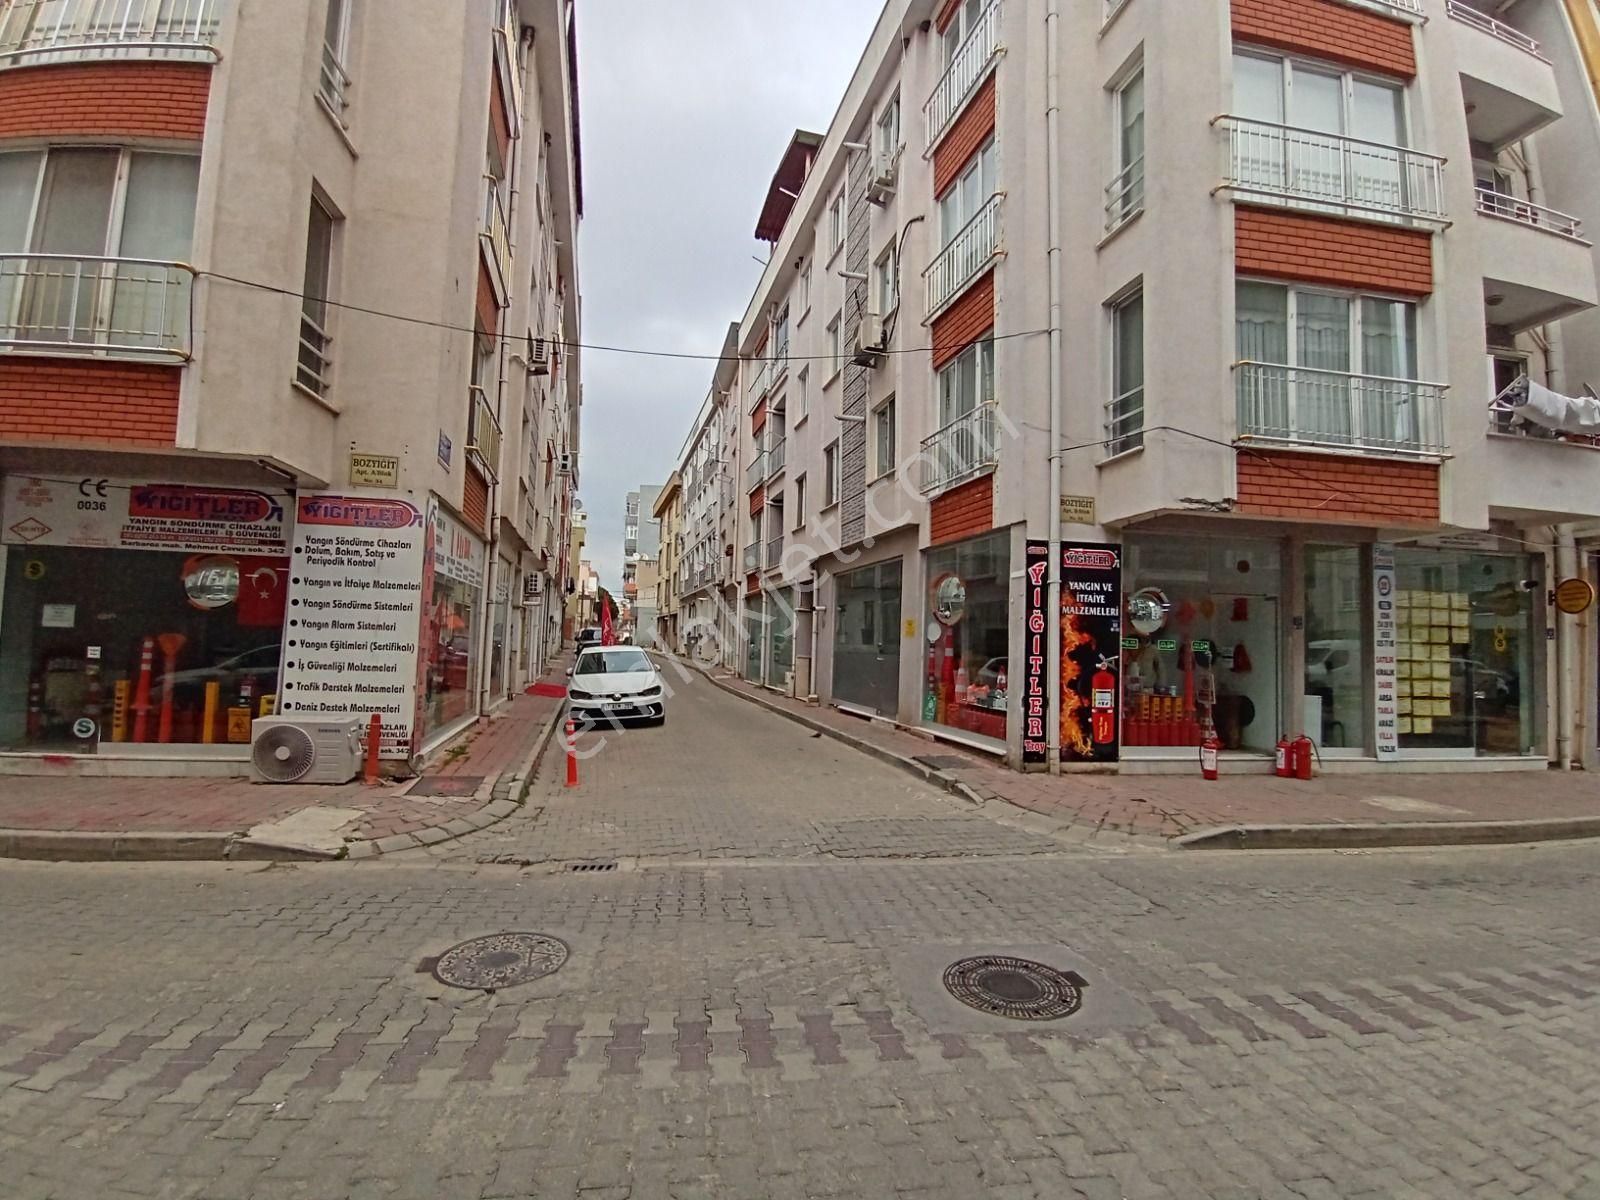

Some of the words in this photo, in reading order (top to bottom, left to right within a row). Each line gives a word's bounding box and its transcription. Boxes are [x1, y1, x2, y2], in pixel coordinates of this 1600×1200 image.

[79, 479, 108, 497] CE
[77, 501, 106, 511] 0036
[129, 518, 168, 526] YANGIN
[229, 523, 281, 532] CİHAZLARI
[306, 535, 334, 546] Yangın
[336, 537, 375, 547] Söndürme
[377, 539, 412, 549] Cihazları
[305, 546, 332, 556] Dolum,
[335, 547, 362, 557] Bakım,
[365, 549, 384, 560] Satış
[307, 556, 344, 567] Periyodik
[347, 557, 376, 567] Kontrol
[304, 577, 331, 588] Yangın
[344, 576, 370, 590] İtfaiye
[373, 580, 421, 591] Malzemeleri
[1068, 581, 1100, 592] YANGIN
[1102, 583, 1112, 592] VE
[1076, 592, 1105, 603] İTFAİYE
[303, 599, 330, 610] Yangın
[332, 599, 372, 610] Söndürme
[374, 601, 413, 611] Sistemleri
[1061, 606, 1119, 616] MALZEMELERİ
[301, 619, 329, 630] Yangın
[331, 620, 355, 630] Alarm
[357, 621, 396, 631] Sistemleri
[300, 639, 328, 651] Yangın
[330, 640, 368, 652] Eğitimleri
[369, 642, 415, 653] (Sertifikalı)
[298, 658, 304, 672] İş
[307, 660, 345, 673] Güvenliği
[347, 661, 397, 673] Malzemeleri
[297, 682, 320, 692] Trafik
[322, 683, 353, 693] Derstek
[355, 683, 405, 694] Malzemeleri
[295, 701, 318, 712] Deniz
[320, 702, 348, 712] Destek
[350, 703, 400, 713] Malzemeleri
[77, 720, 91, 734] S
[1024, 740, 1046, 753] Troy
